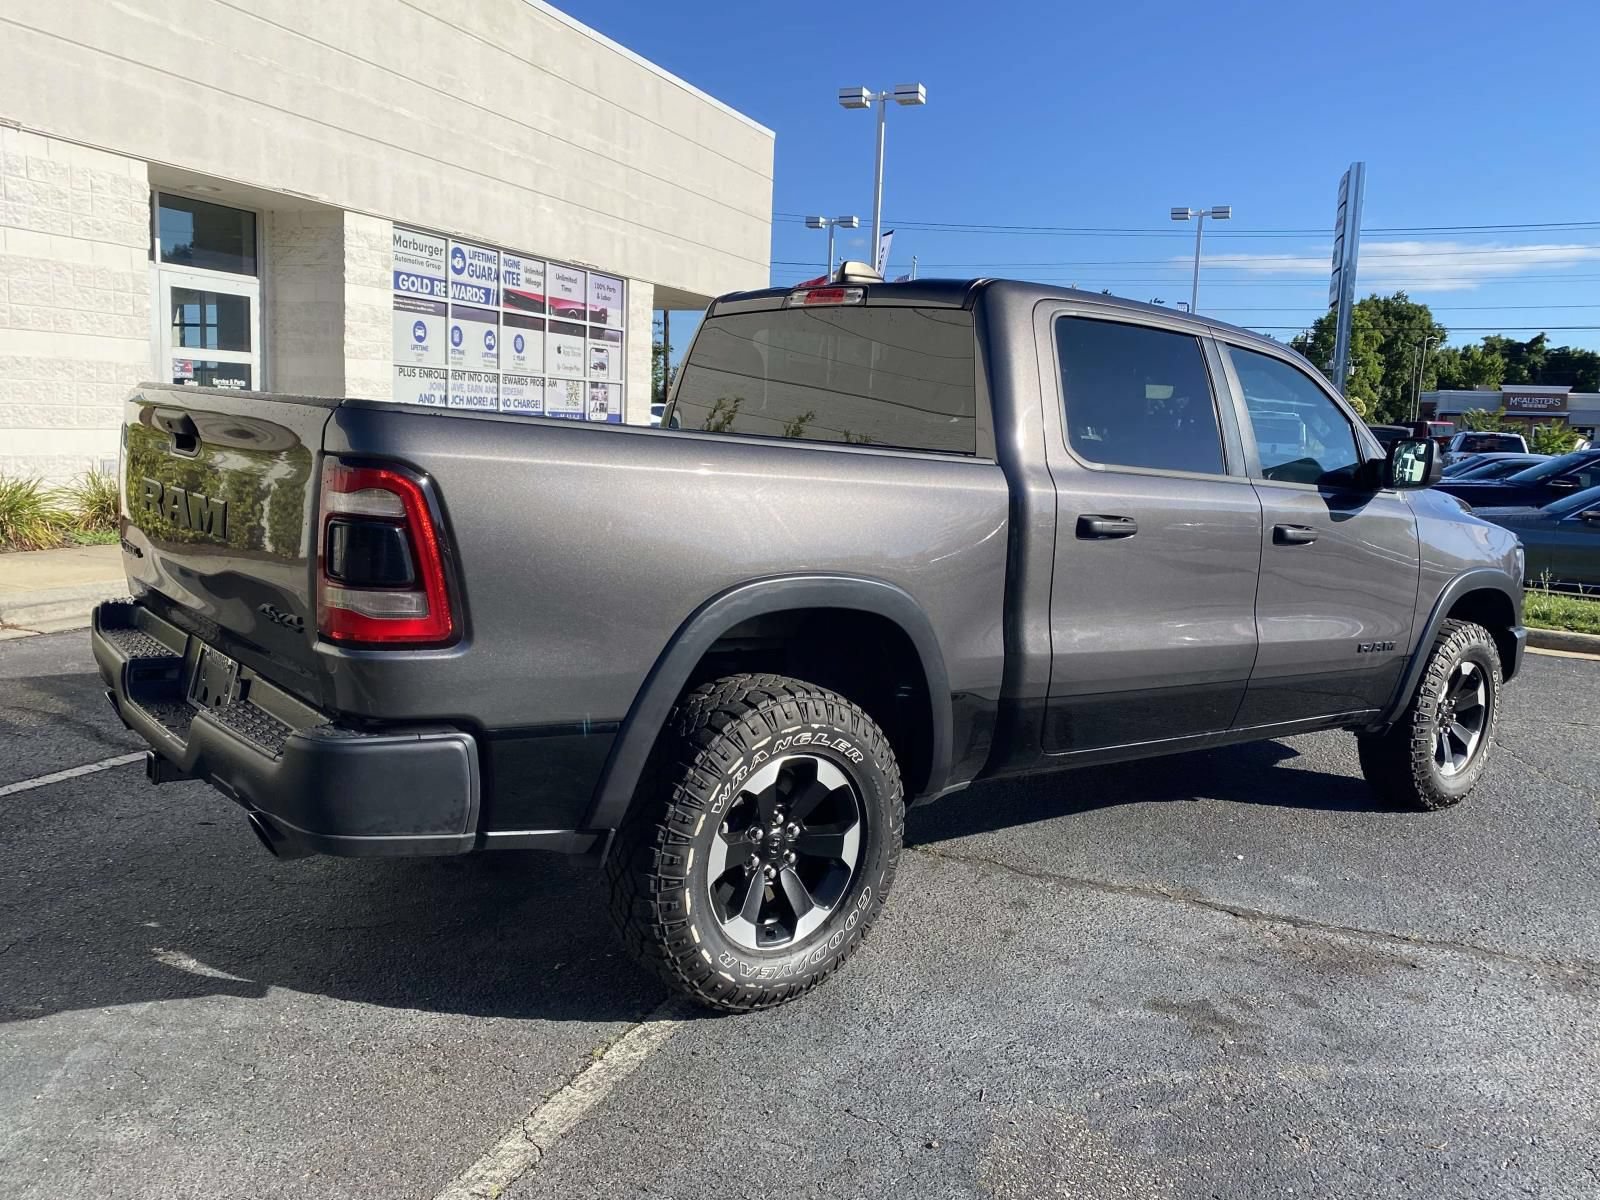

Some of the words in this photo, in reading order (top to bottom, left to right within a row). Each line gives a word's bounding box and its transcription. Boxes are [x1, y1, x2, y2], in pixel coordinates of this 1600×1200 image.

[392, 233, 444, 257] Marburger
[394, 253, 425, 267] Automotive
[425, 260, 442, 271] Group
[468, 249, 496, 265] LIFETIME
[503, 257, 521, 270] NGINE
[467, 262, 521, 287] GUARANTEE
[524, 265, 544, 277] Unlimited
[555, 273, 577, 284] Unlimited
[398, 274, 431, 294] GOLD
[433, 280, 486, 303] REWARDS
[525, 277, 542, 288] Mileage
[561, 284, 572, 293] Time
[411, 344, 429, 352] LIFETIME
[398, 367, 417, 378] PLUS
[467, 373, 483, 383] INTO
[483, 374, 497, 383] OUR
[529, 378, 558, 389] PROGAM
[467, 384, 484, 393] EARN
[484, 384, 497, 394] AND
[418, 393, 436, 404] AND
[466, 396, 488, 406] MORE!
[489, 397, 498, 408] AT
[502, 398, 511, 408] NO
[513, 399, 541, 409] CHARGE!
[142, 476, 228, 540] RAM
[1356, 641, 1397, 654] RAM
[711, 731, 864, 814] WRANGLER
[718, 886, 872, 980] GOODYEAR
